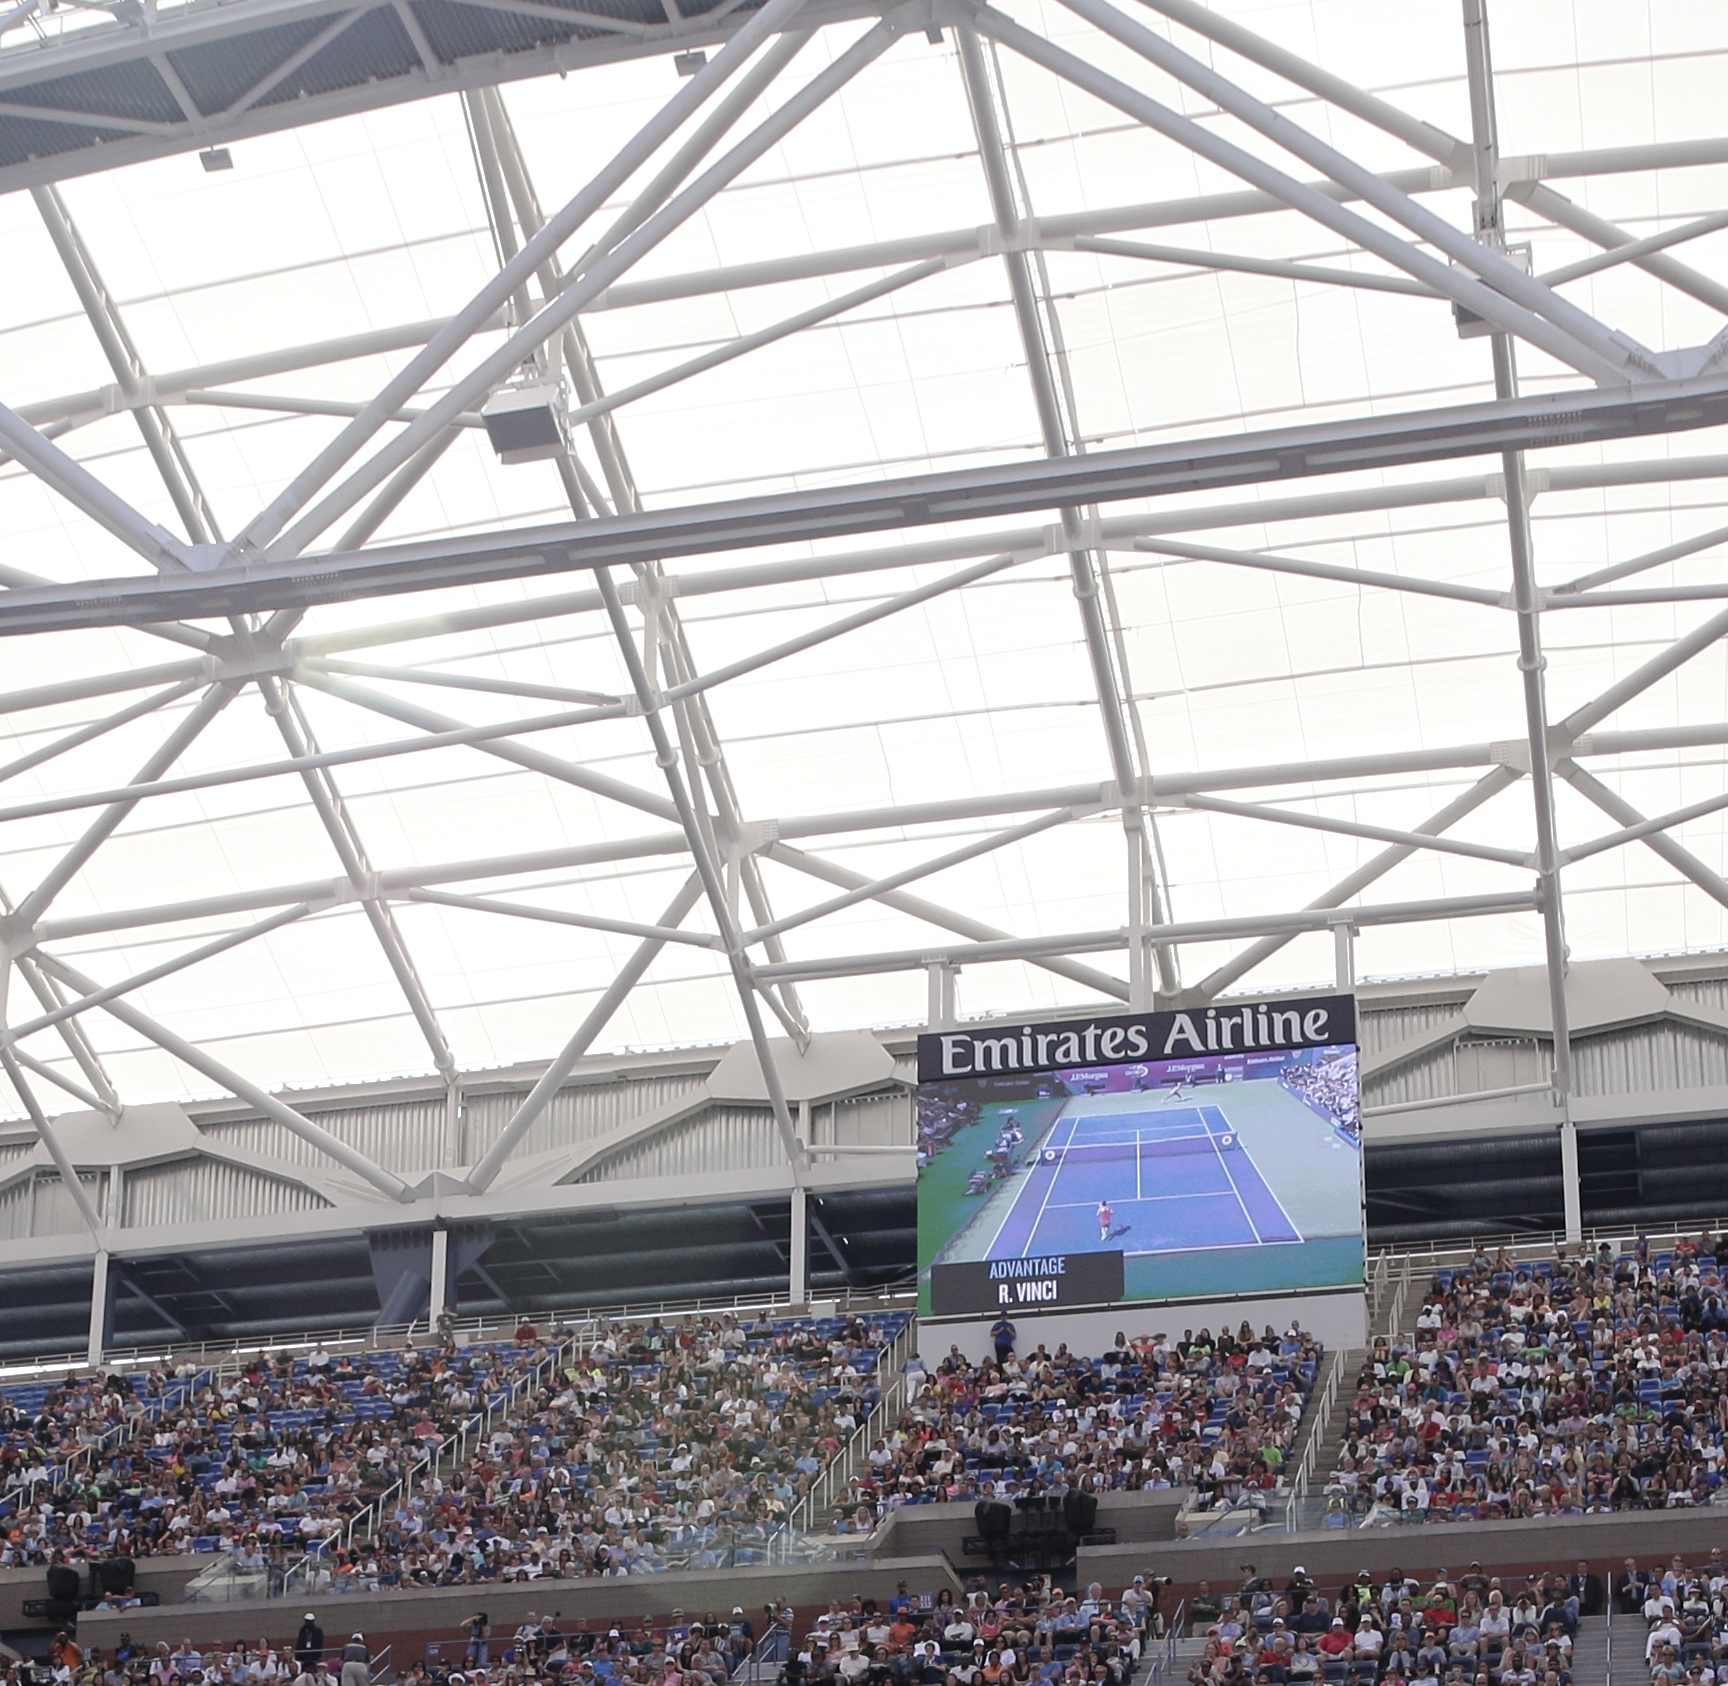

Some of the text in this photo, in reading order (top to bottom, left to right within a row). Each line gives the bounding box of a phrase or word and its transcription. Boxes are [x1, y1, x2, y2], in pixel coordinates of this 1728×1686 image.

[940, 1004, 1329, 1075] Emirates Airline
[989, 1258, 1065, 1280] ADVANTAGE
[998, 1280, 1057, 1304] R. VINCI
